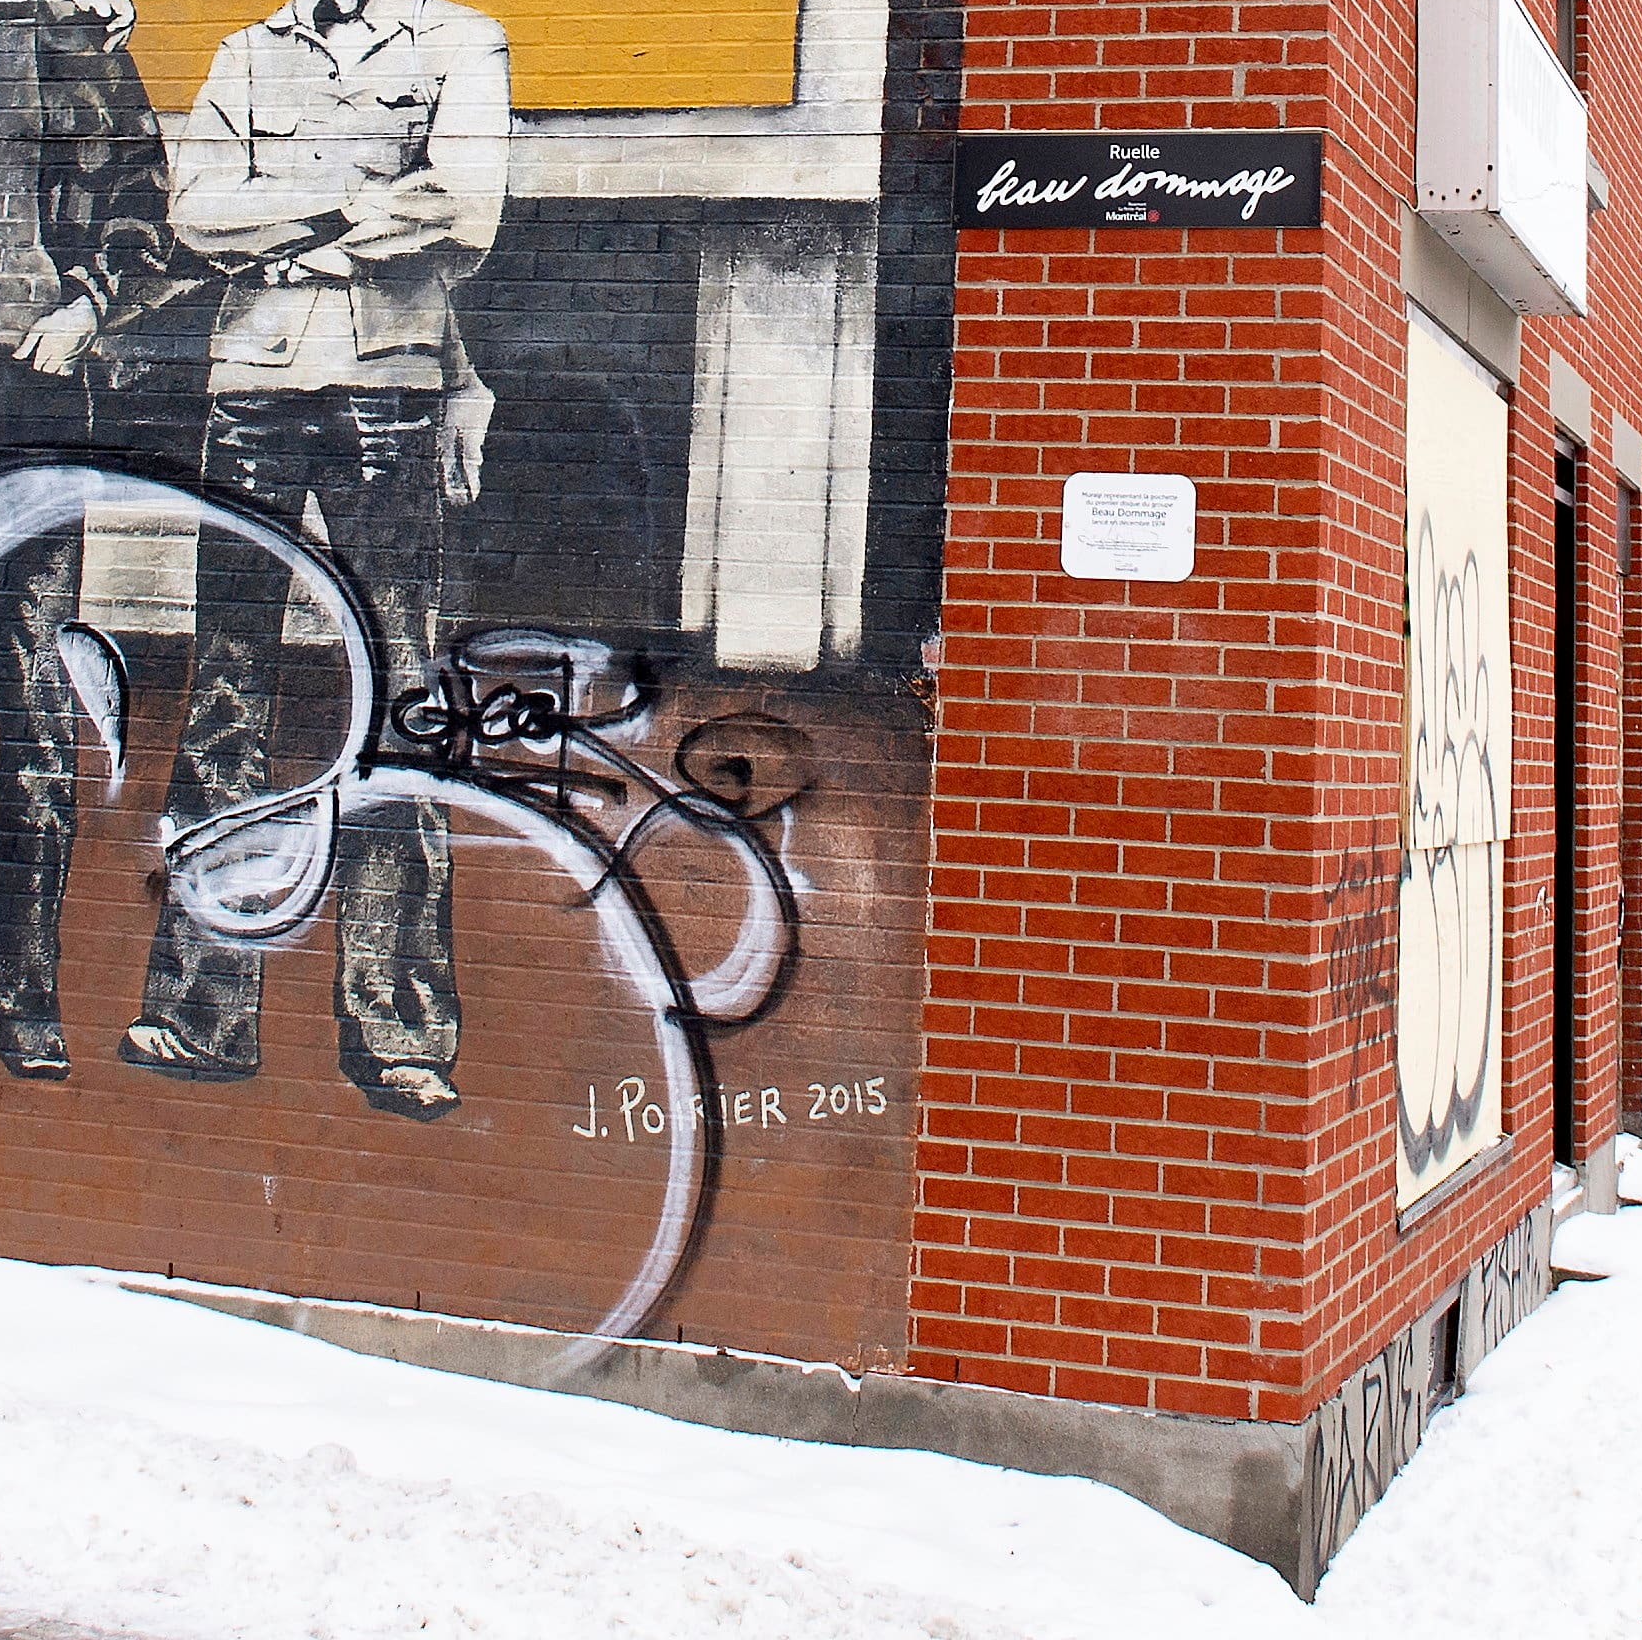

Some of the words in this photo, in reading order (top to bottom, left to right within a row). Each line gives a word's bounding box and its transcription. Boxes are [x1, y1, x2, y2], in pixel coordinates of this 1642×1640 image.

[1109, 144, 1161, 160] Ruelle
[976, 160, 1088, 212] beau
[1093, 163, 1295, 220] dommage
[1105, 211, 1147, 222] Montréal
[1092, 507, 1115, 517] Beau
[1117, 508, 1167, 520] Dommage
[572, 1085, 609, 1138] J.
[807, 1076, 887, 1121] 2015
